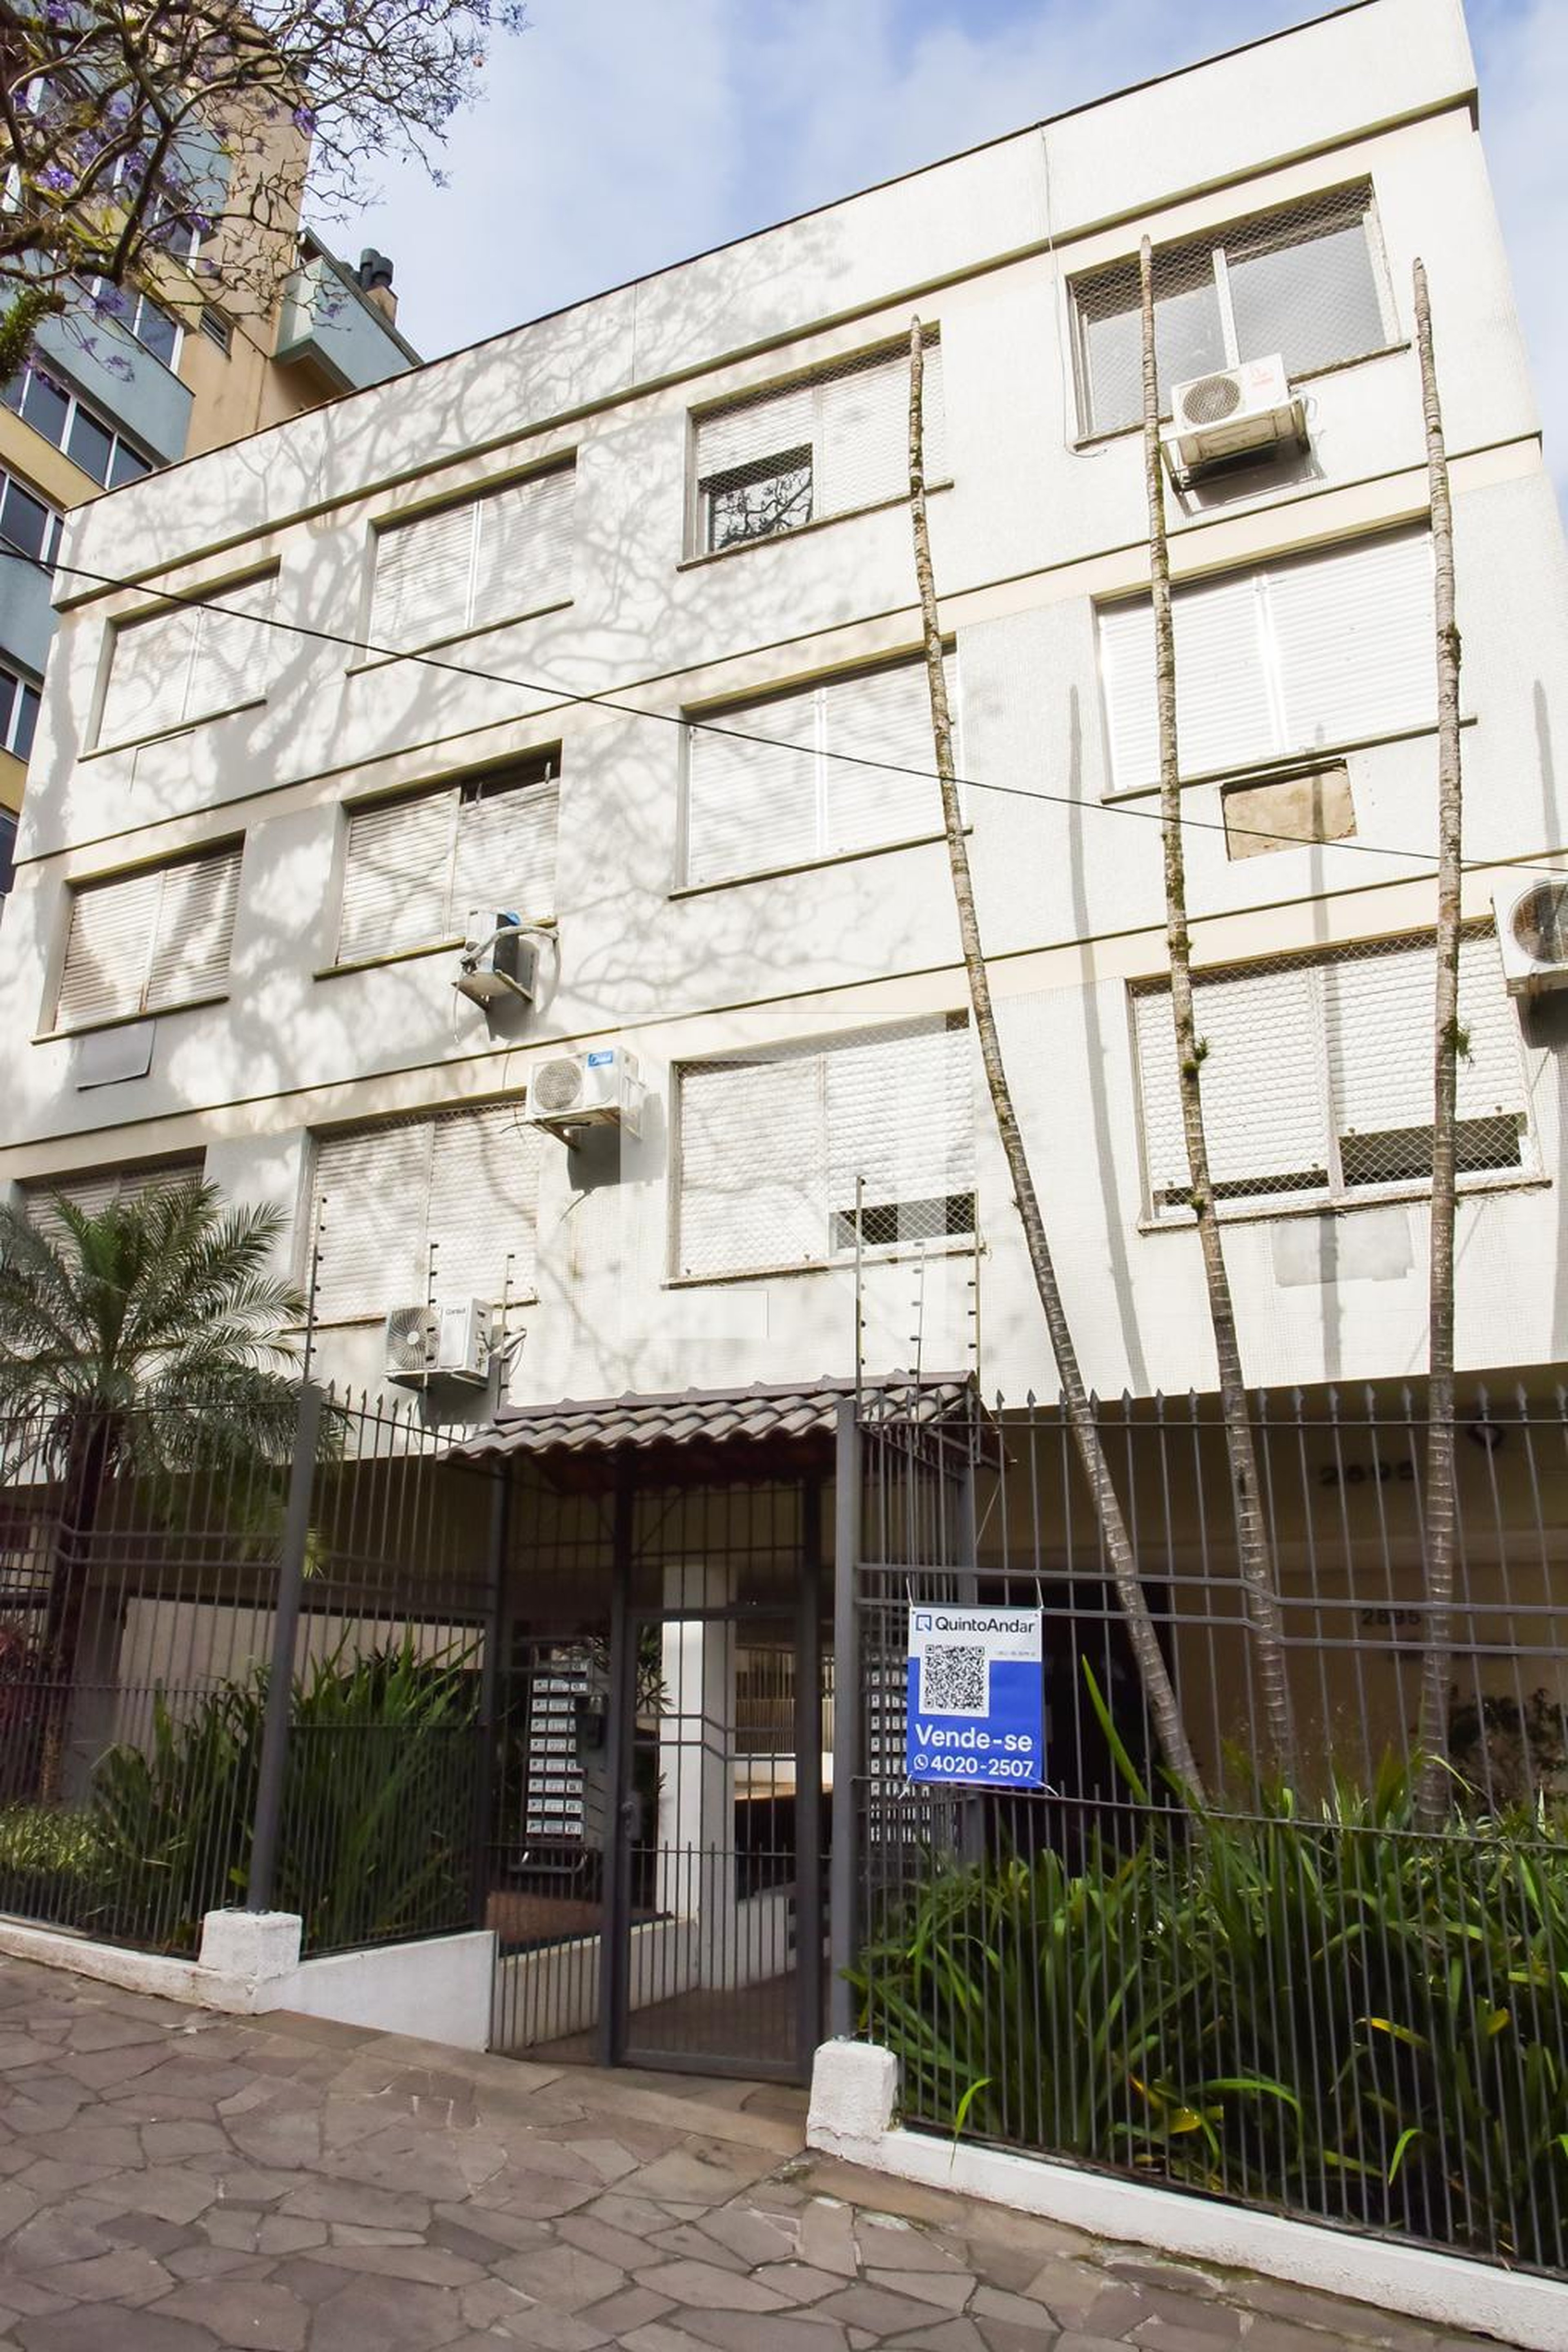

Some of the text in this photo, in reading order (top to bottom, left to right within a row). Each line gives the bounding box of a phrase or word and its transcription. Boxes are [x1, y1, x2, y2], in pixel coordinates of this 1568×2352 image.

[935, 1617, 1035, 1633] QuintoAndar
[915, 1724, 1032, 1752] Vende-se
[931, 1755, 1033, 1777] 4020-2507
